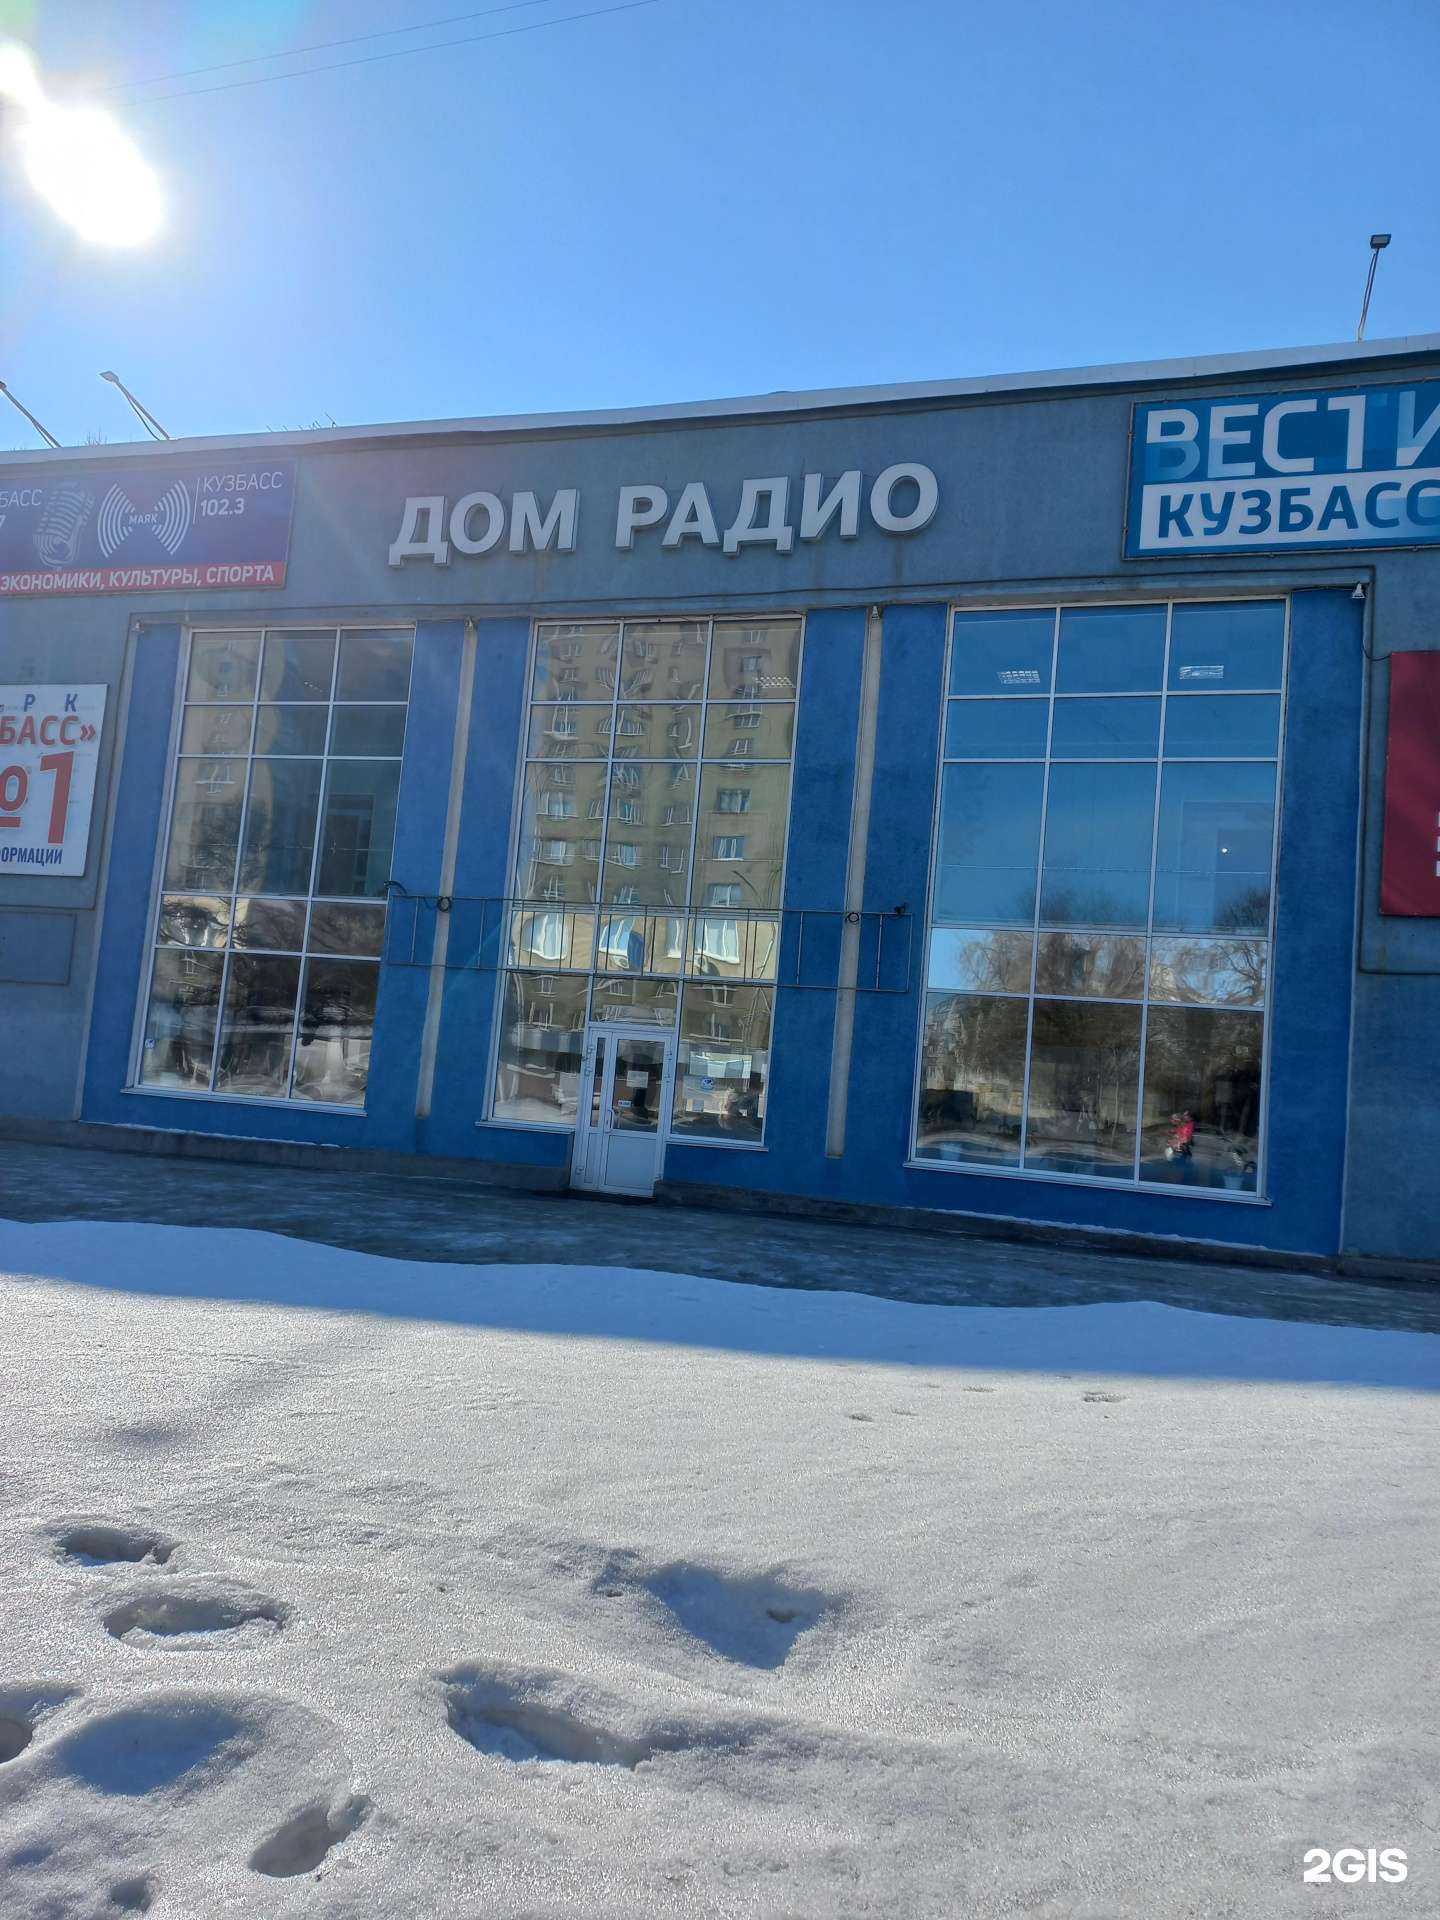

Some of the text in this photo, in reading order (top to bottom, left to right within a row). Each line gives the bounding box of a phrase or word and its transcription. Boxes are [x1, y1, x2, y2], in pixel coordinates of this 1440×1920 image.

[1145, 390, 1440, 481] ВЕСТИ
[202, 471, 283, 493] КУЗБАСС
[129, 514, 158, 525] МАЯК
[200, 498, 245, 517] 102.3
[388, 462, 939, 567] ДОМ РАДИО
[1158, 479, 1440, 538] КУЗБАСС
[0, 564, 275, 592] ЭКОНОМИКИ, КУЛЬТУРЫ, СПОРТА
